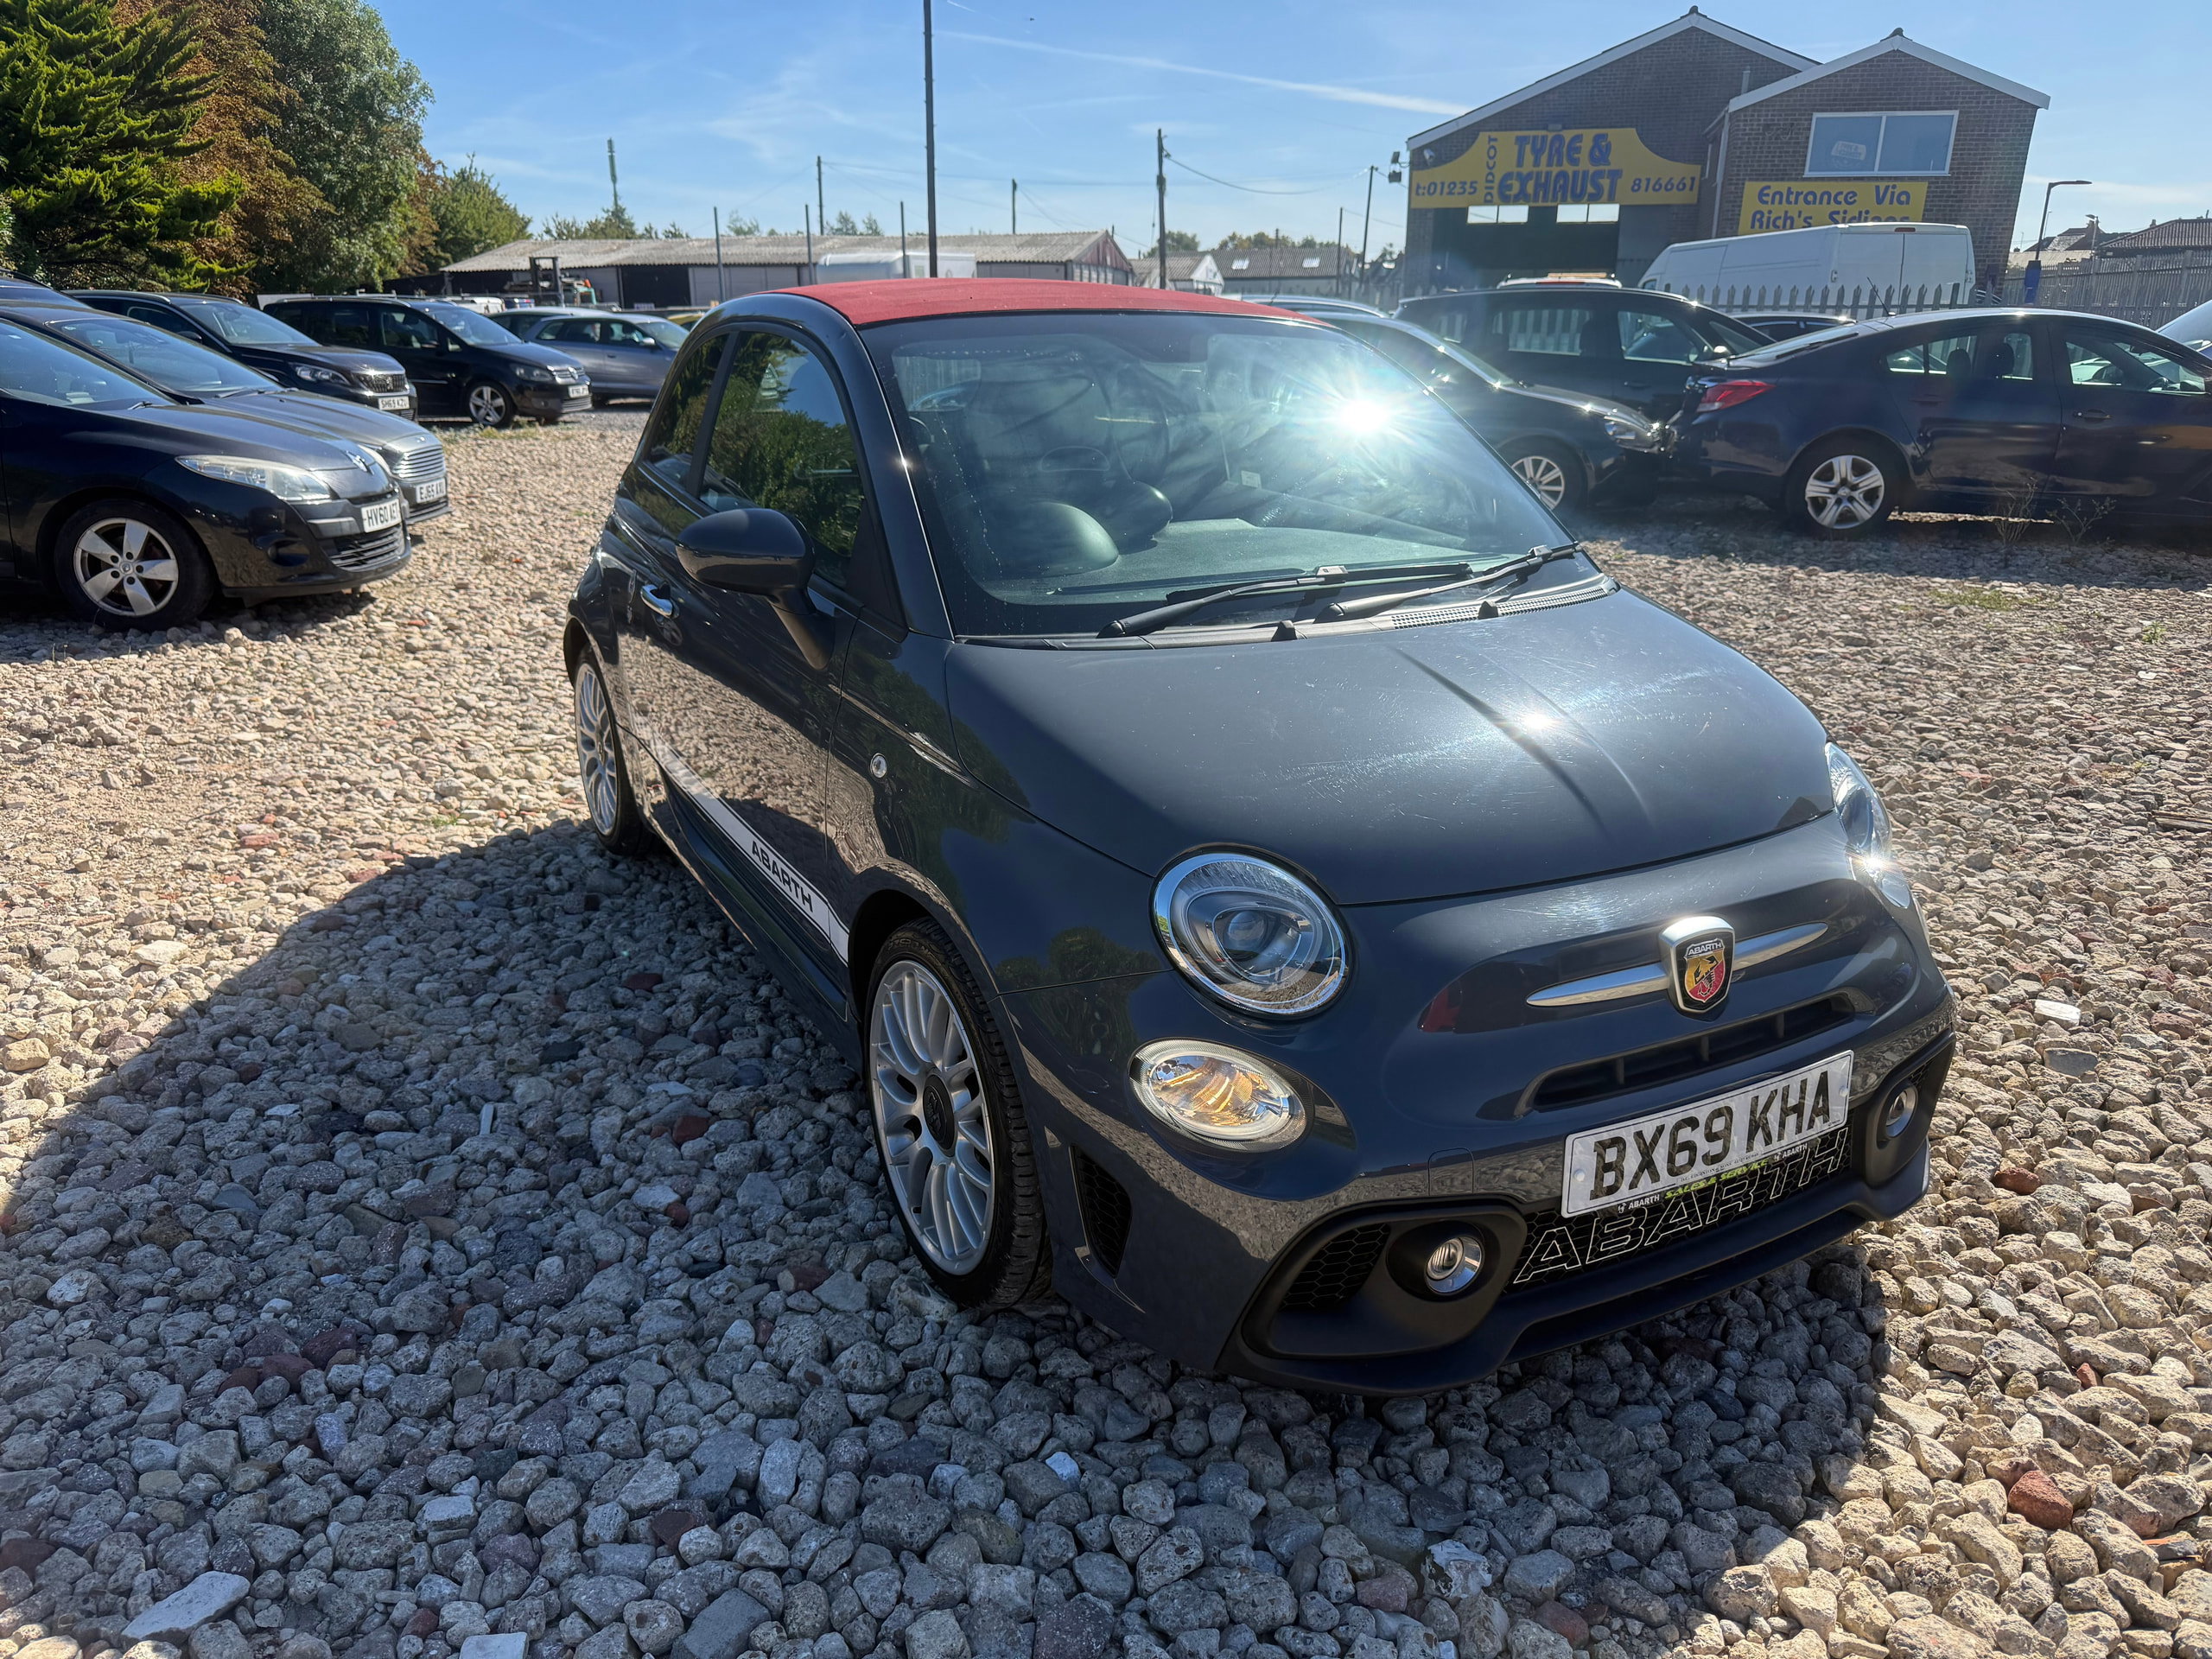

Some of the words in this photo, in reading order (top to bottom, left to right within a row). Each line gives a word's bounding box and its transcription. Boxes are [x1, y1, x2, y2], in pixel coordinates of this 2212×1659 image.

[1514, 134, 1583, 168] TYRE
[1588, 133, 1611, 167] &
[1483, 135, 1498, 204] DIDCOT
[1414, 181, 1478, 196] t:01235
[1497, 169, 1623, 203] EXHAUST
[1630, 176, 1697, 194] 816661
[1757, 185, 1858, 206] Entrance
[1874, 184, 1911, 206] Via
[1750, 210, 1813, 230] Rich's
[365, 505, 389, 527] HV60
[752, 841, 814, 913] ABARTH
[1688, 942, 1722, 956] ABARTH
[1589, 1104, 1733, 1202] BX69
[1745, 1070, 1832, 1154] KHA
[1782, 1143, 1808, 1159] ABARTH
[1665, 1180, 1707, 1199] SALES
[1719, 1158, 1770, 1181] SERVICE
[1513, 1126, 1849, 1285] ABARTH
[1628, 1194, 1660, 1210] ABARTH
